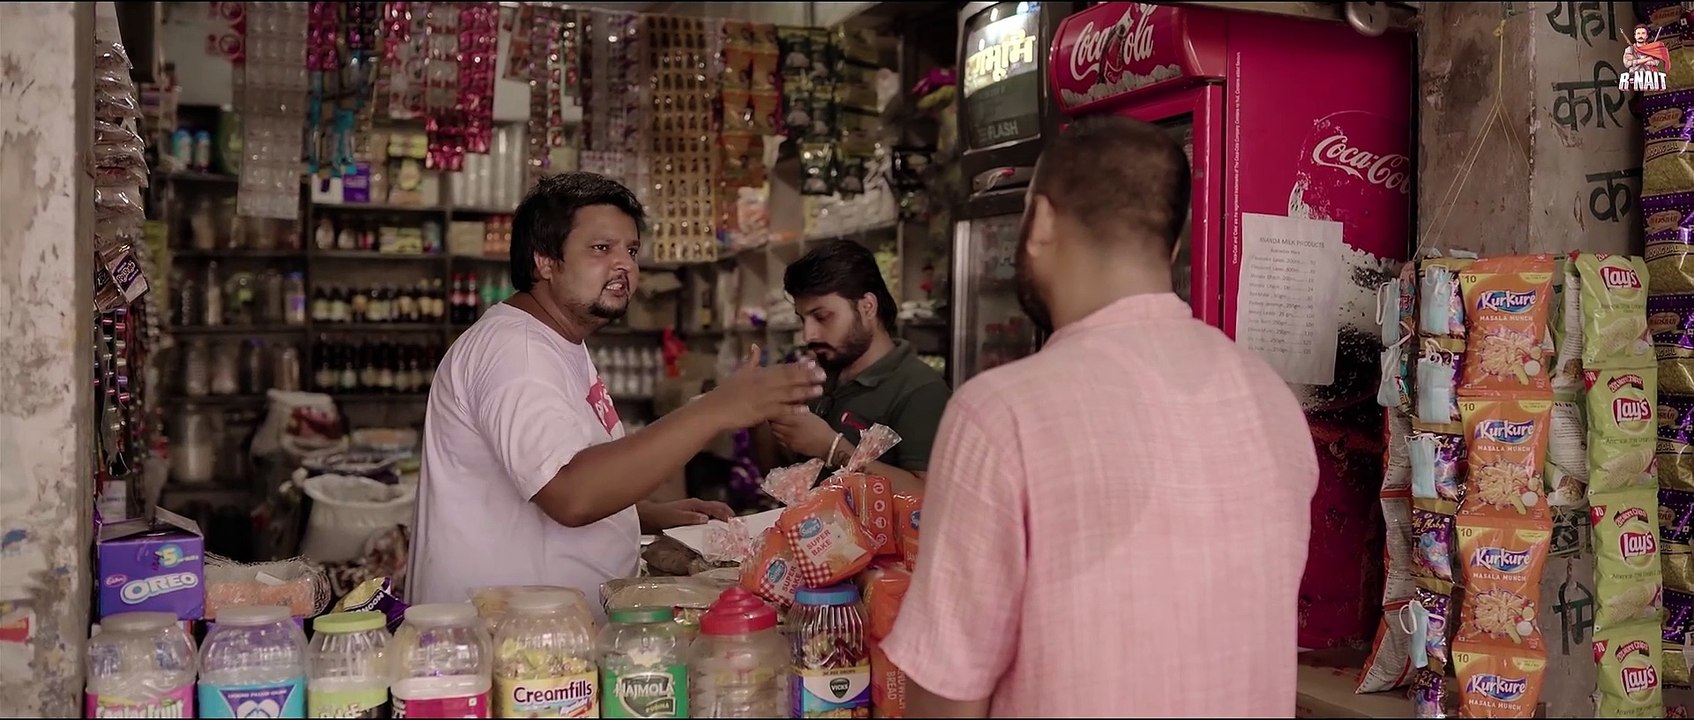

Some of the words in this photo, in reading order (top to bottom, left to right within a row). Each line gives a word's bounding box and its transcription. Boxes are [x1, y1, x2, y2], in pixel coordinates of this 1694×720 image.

[1312, 134, 1410, 194] Coca-Co
[1603, 267, 1637, 289] Lay's
[1480, 291, 1536, 312] Kurkure
[1463, 403, 1475, 411] 10
[1616, 399, 1649, 422] Lay's
[1480, 420, 1534, 442] Kurkure
[806, 529, 831, 550] SUPER
[1461, 528, 1472, 537] 10
[811, 539, 832, 556] BAKE
[1623, 533, 1653, 557] Lay's
[1476, 548, 1530, 570] Kurkure
[782, 565, 797, 592] SUPER
[1473, 572, 1500, 580] MASALA
[122, 573, 197, 602] OREO
[1458, 654, 1469, 663] 10
[615, 681, 675, 698] HAJMOLA
[886, 671, 897, 700] BREAD
[1471, 675, 1526, 697] Kurkure
[1623, 666, 1655, 693] Lay's
[514, 680, 592, 704] Creamfills
[1469, 699, 1496, 708] MASALA
[1497, 702, 1522, 710] MUNCH
